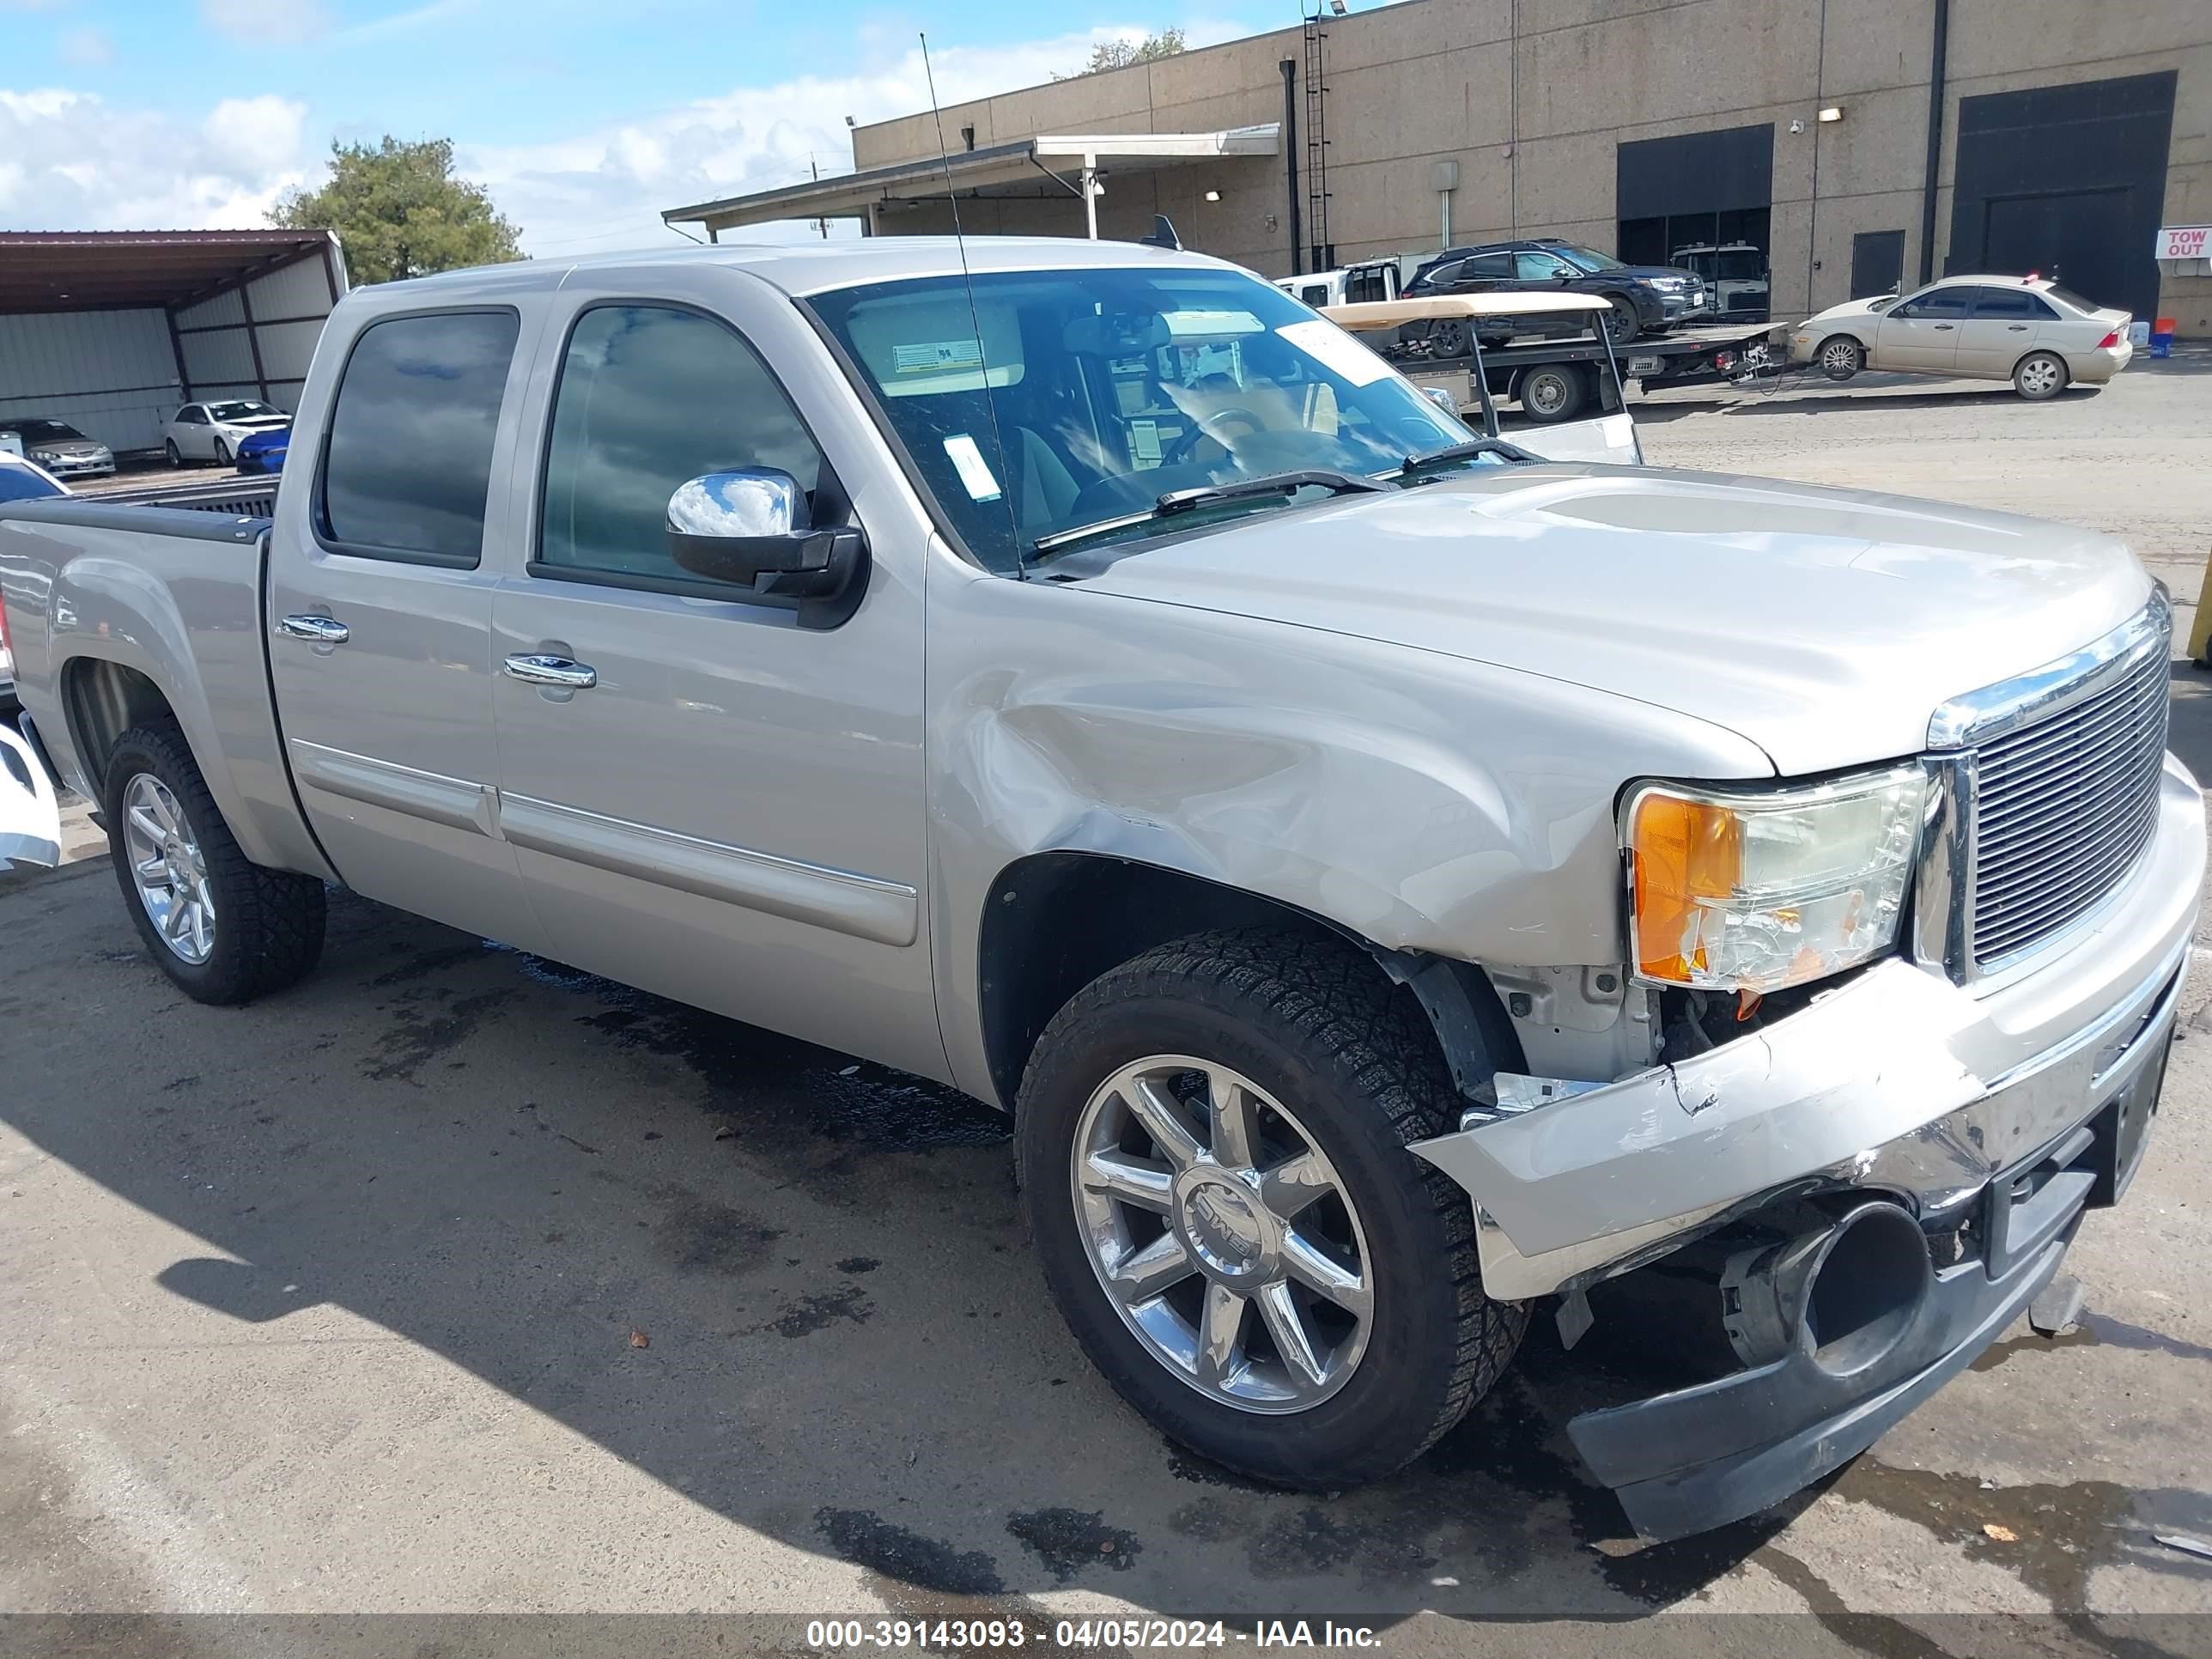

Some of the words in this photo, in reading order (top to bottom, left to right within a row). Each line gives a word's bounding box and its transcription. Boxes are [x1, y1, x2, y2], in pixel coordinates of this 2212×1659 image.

[2169, 231, 2207, 243] TOW
[2168, 244, 2203, 256] OUT
[1195, 1193, 1250, 1255] GMC
